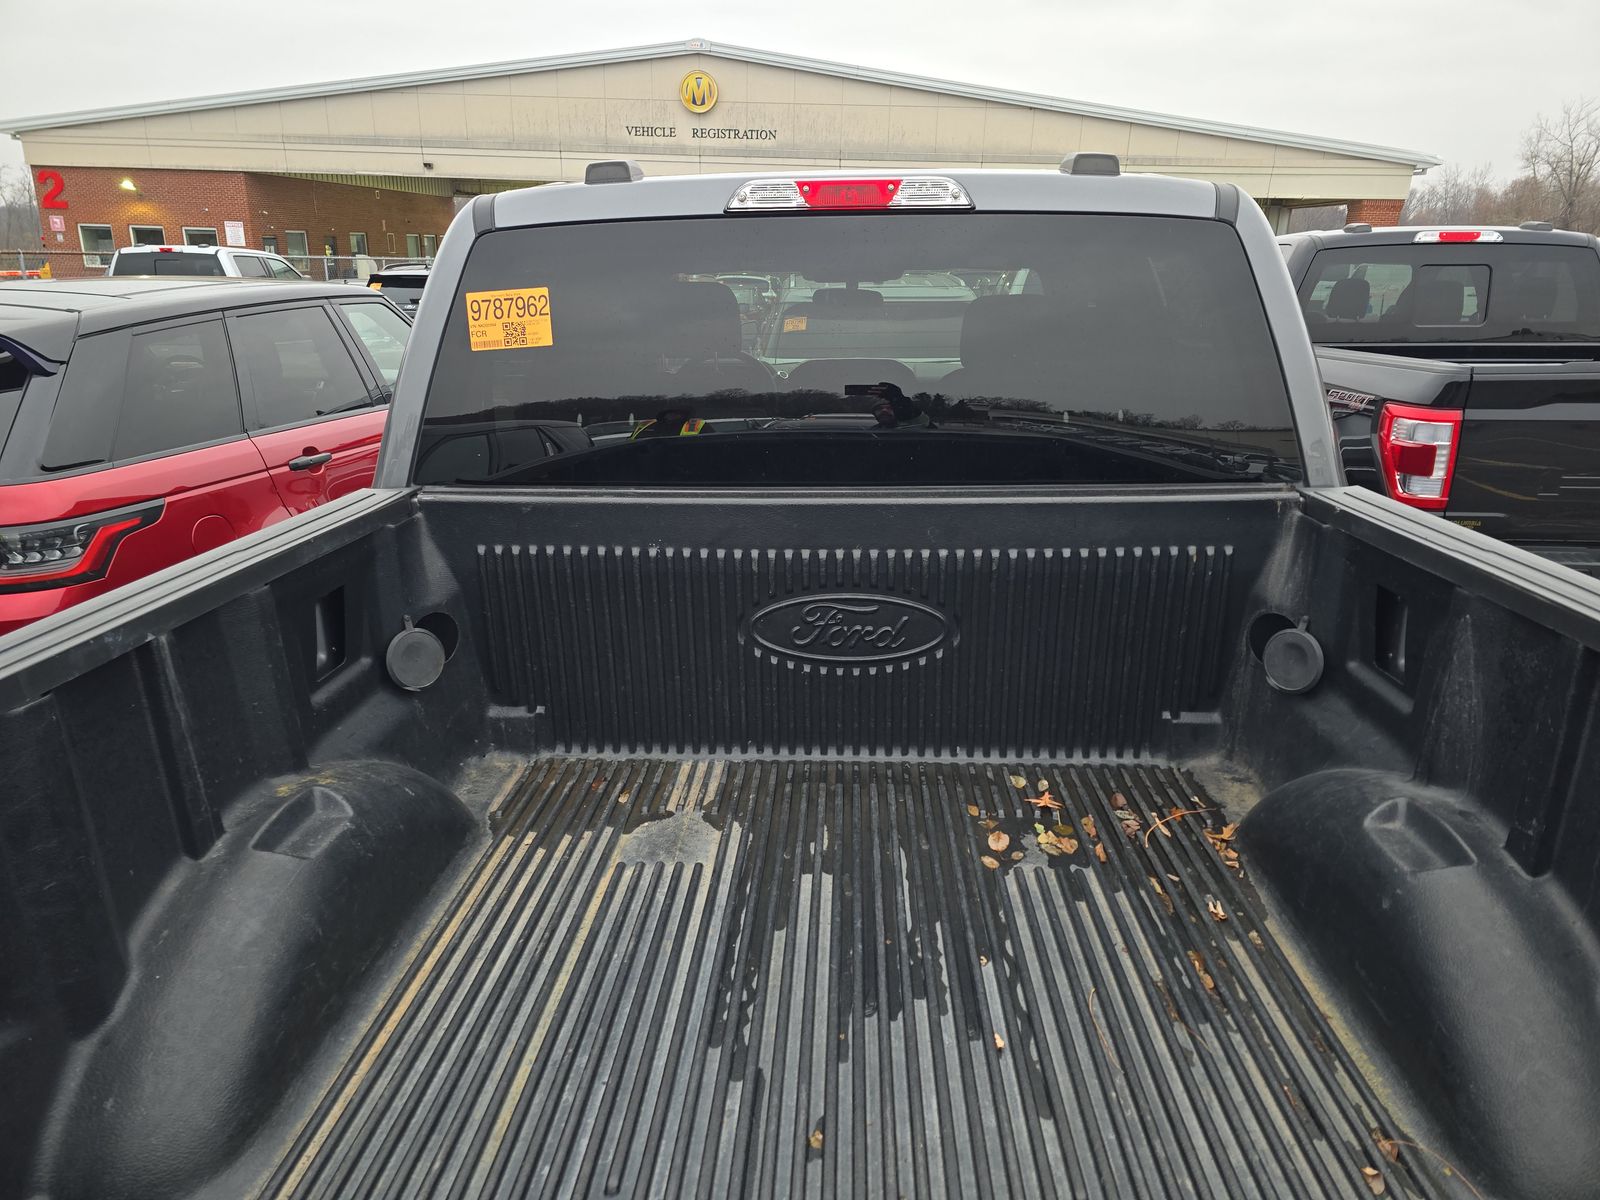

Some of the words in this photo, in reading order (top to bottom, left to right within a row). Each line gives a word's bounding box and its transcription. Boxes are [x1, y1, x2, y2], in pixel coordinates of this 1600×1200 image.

[626, 126, 677, 138] VEHICLE
[692, 128, 777, 140] REGISTRATION
[37, 168, 70, 209] 2
[470, 295, 549, 322] 9787962
[471, 330, 487, 338] FCR
[1328, 389, 1376, 405] SPORT
[790, 602, 910, 649] Ford
